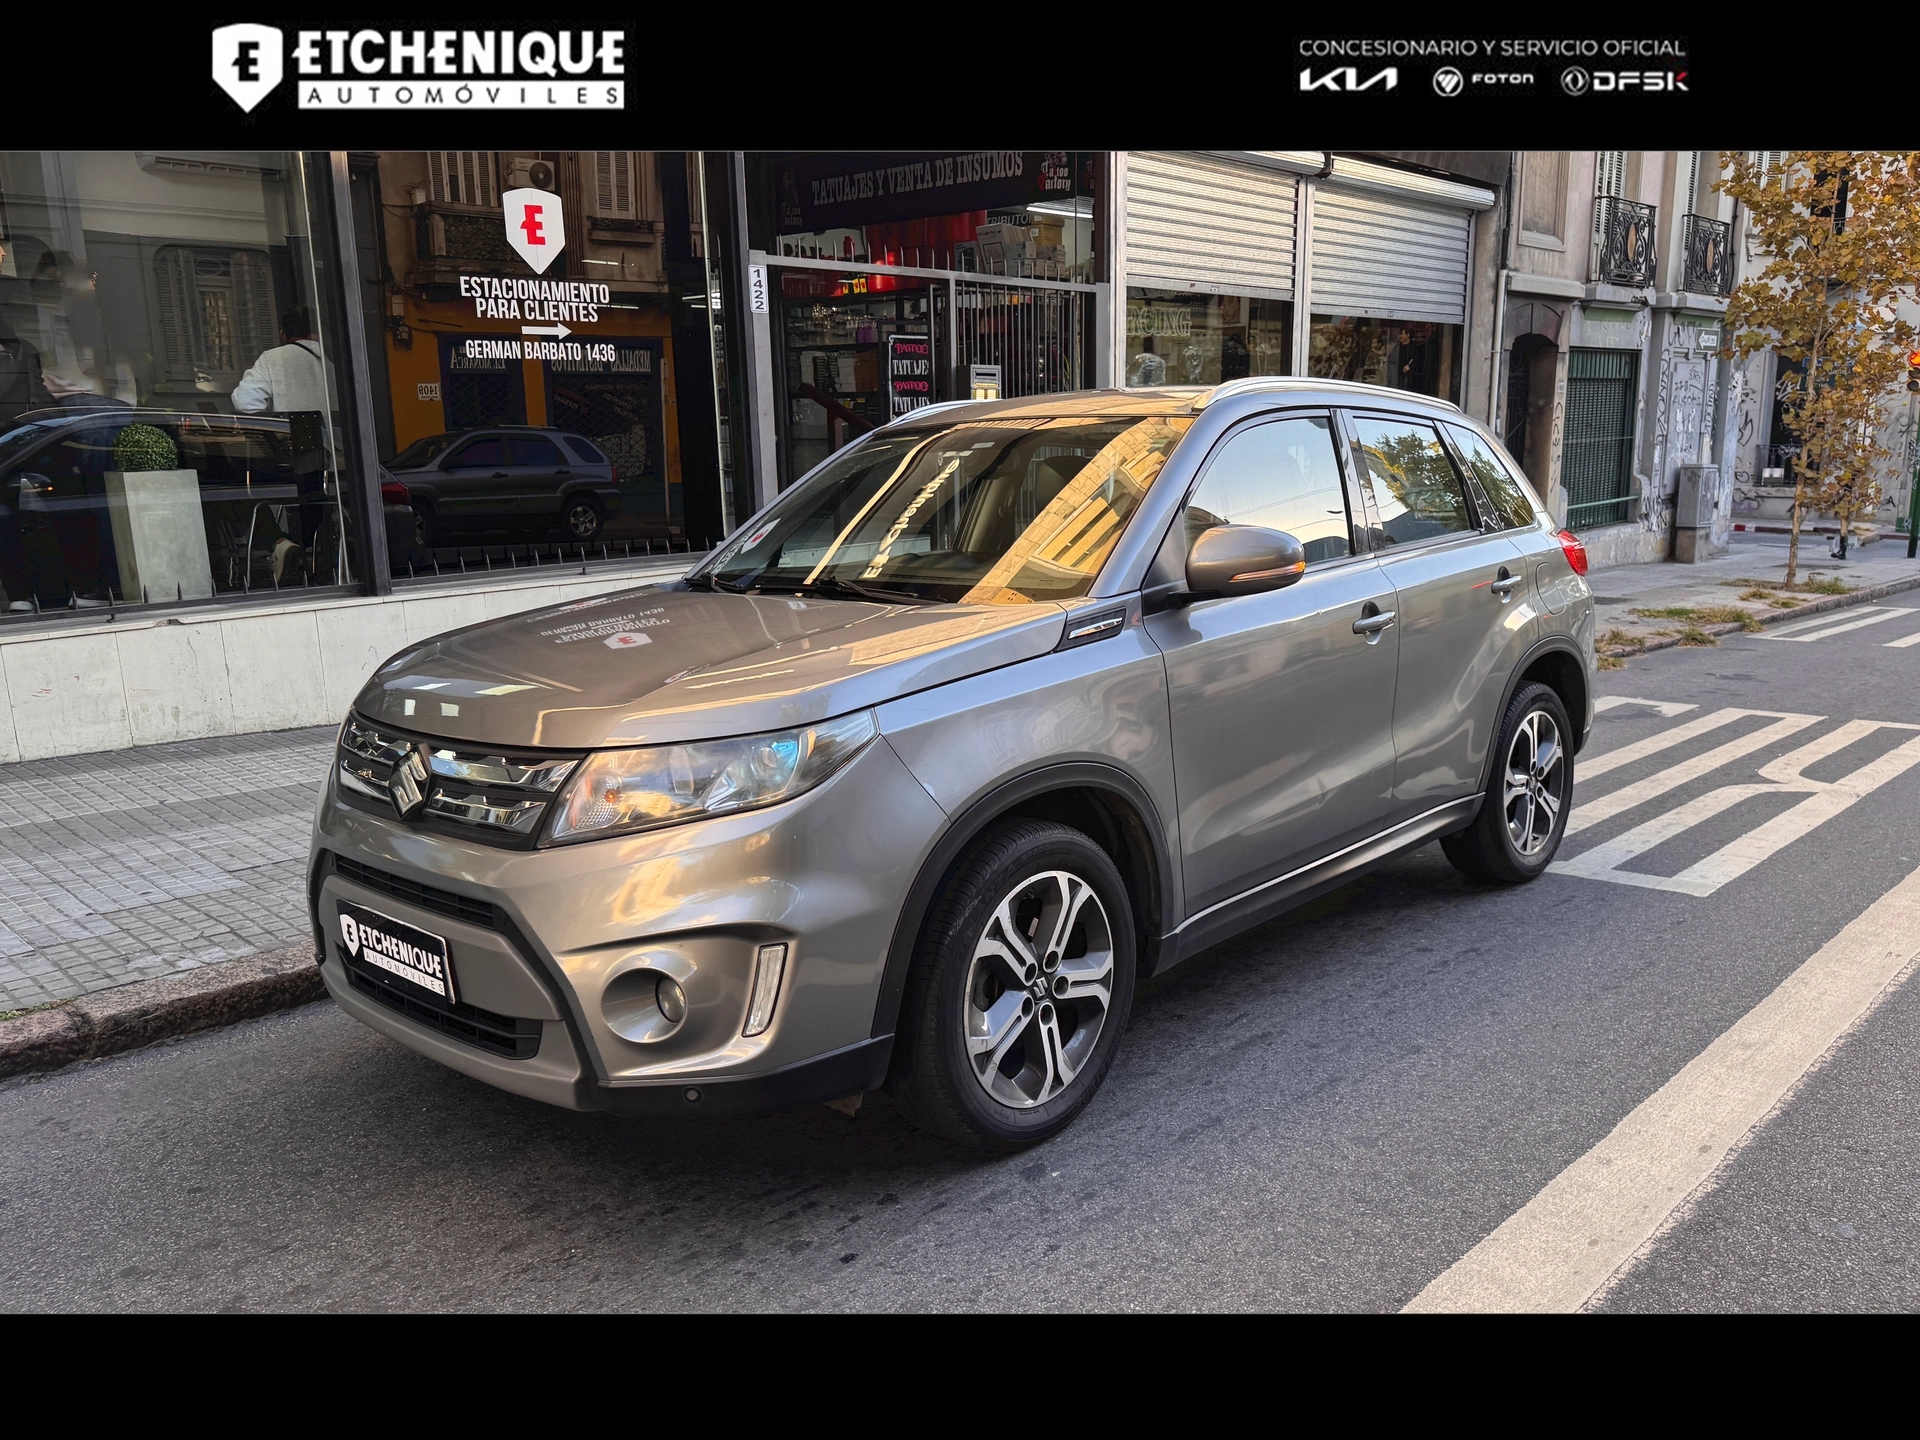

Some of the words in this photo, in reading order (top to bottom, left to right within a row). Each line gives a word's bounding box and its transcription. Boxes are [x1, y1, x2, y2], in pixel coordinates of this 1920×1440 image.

[811, 173, 875, 206] TATUAJES
[874, 170, 885, 196] Y
[887, 164, 934, 195] VENTA
[934, 157, 955, 187] DE
[955, 152, 1024, 185] INSUMOS
[459, 276, 610, 304] ESTACIONAMIENTO
[753, 269, 764, 310] 1422
[475, 298, 521, 320] PARA
[524, 301, 598, 323] CLIENTES
[465, 339, 522, 360] GERMAN
[524, 341, 582, 361] BARBATO
[585, 343, 616, 362] 1436
[358, 923, 443, 979] ETCHENIQUE
